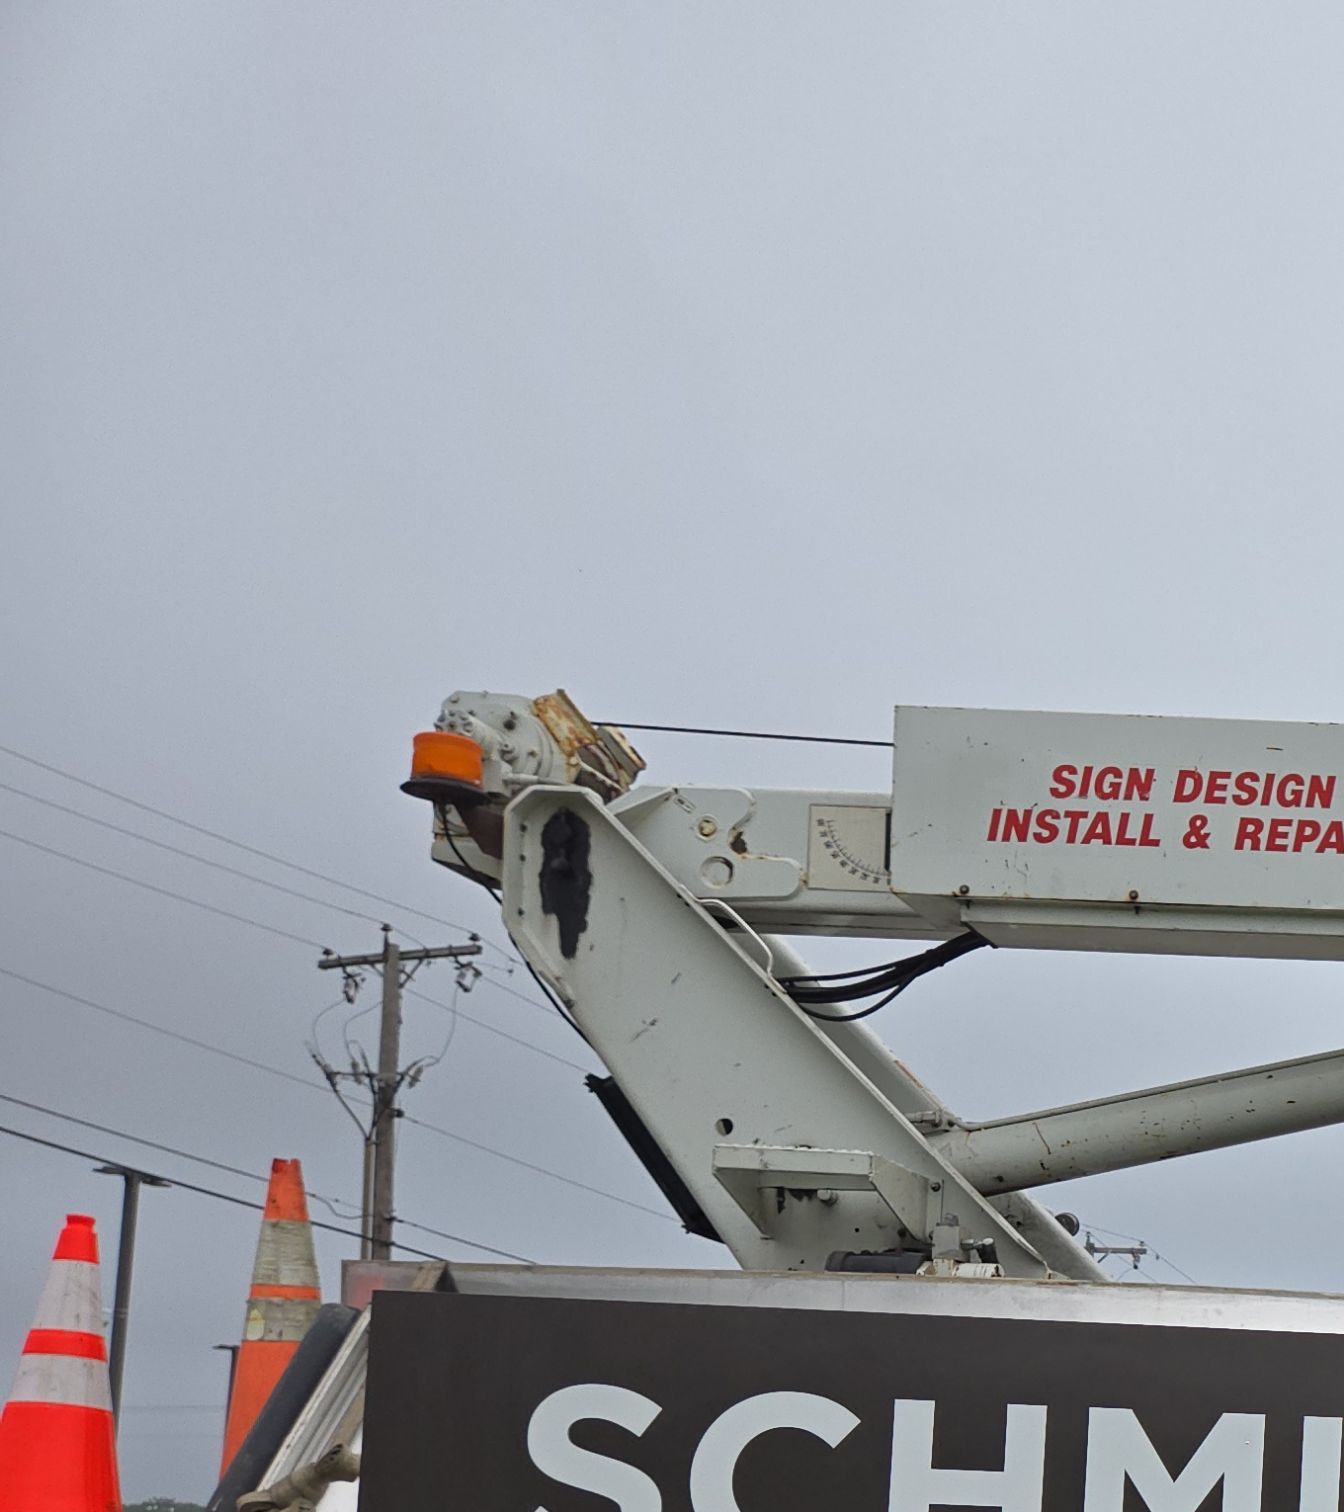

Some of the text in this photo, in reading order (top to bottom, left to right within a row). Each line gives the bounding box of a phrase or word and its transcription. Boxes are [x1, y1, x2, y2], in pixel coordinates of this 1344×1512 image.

[1049, 764, 1337, 809] SIGN DESIGN
[987, 808, 1161, 847] INSTALL
[1182, 814, 1212, 849] &
